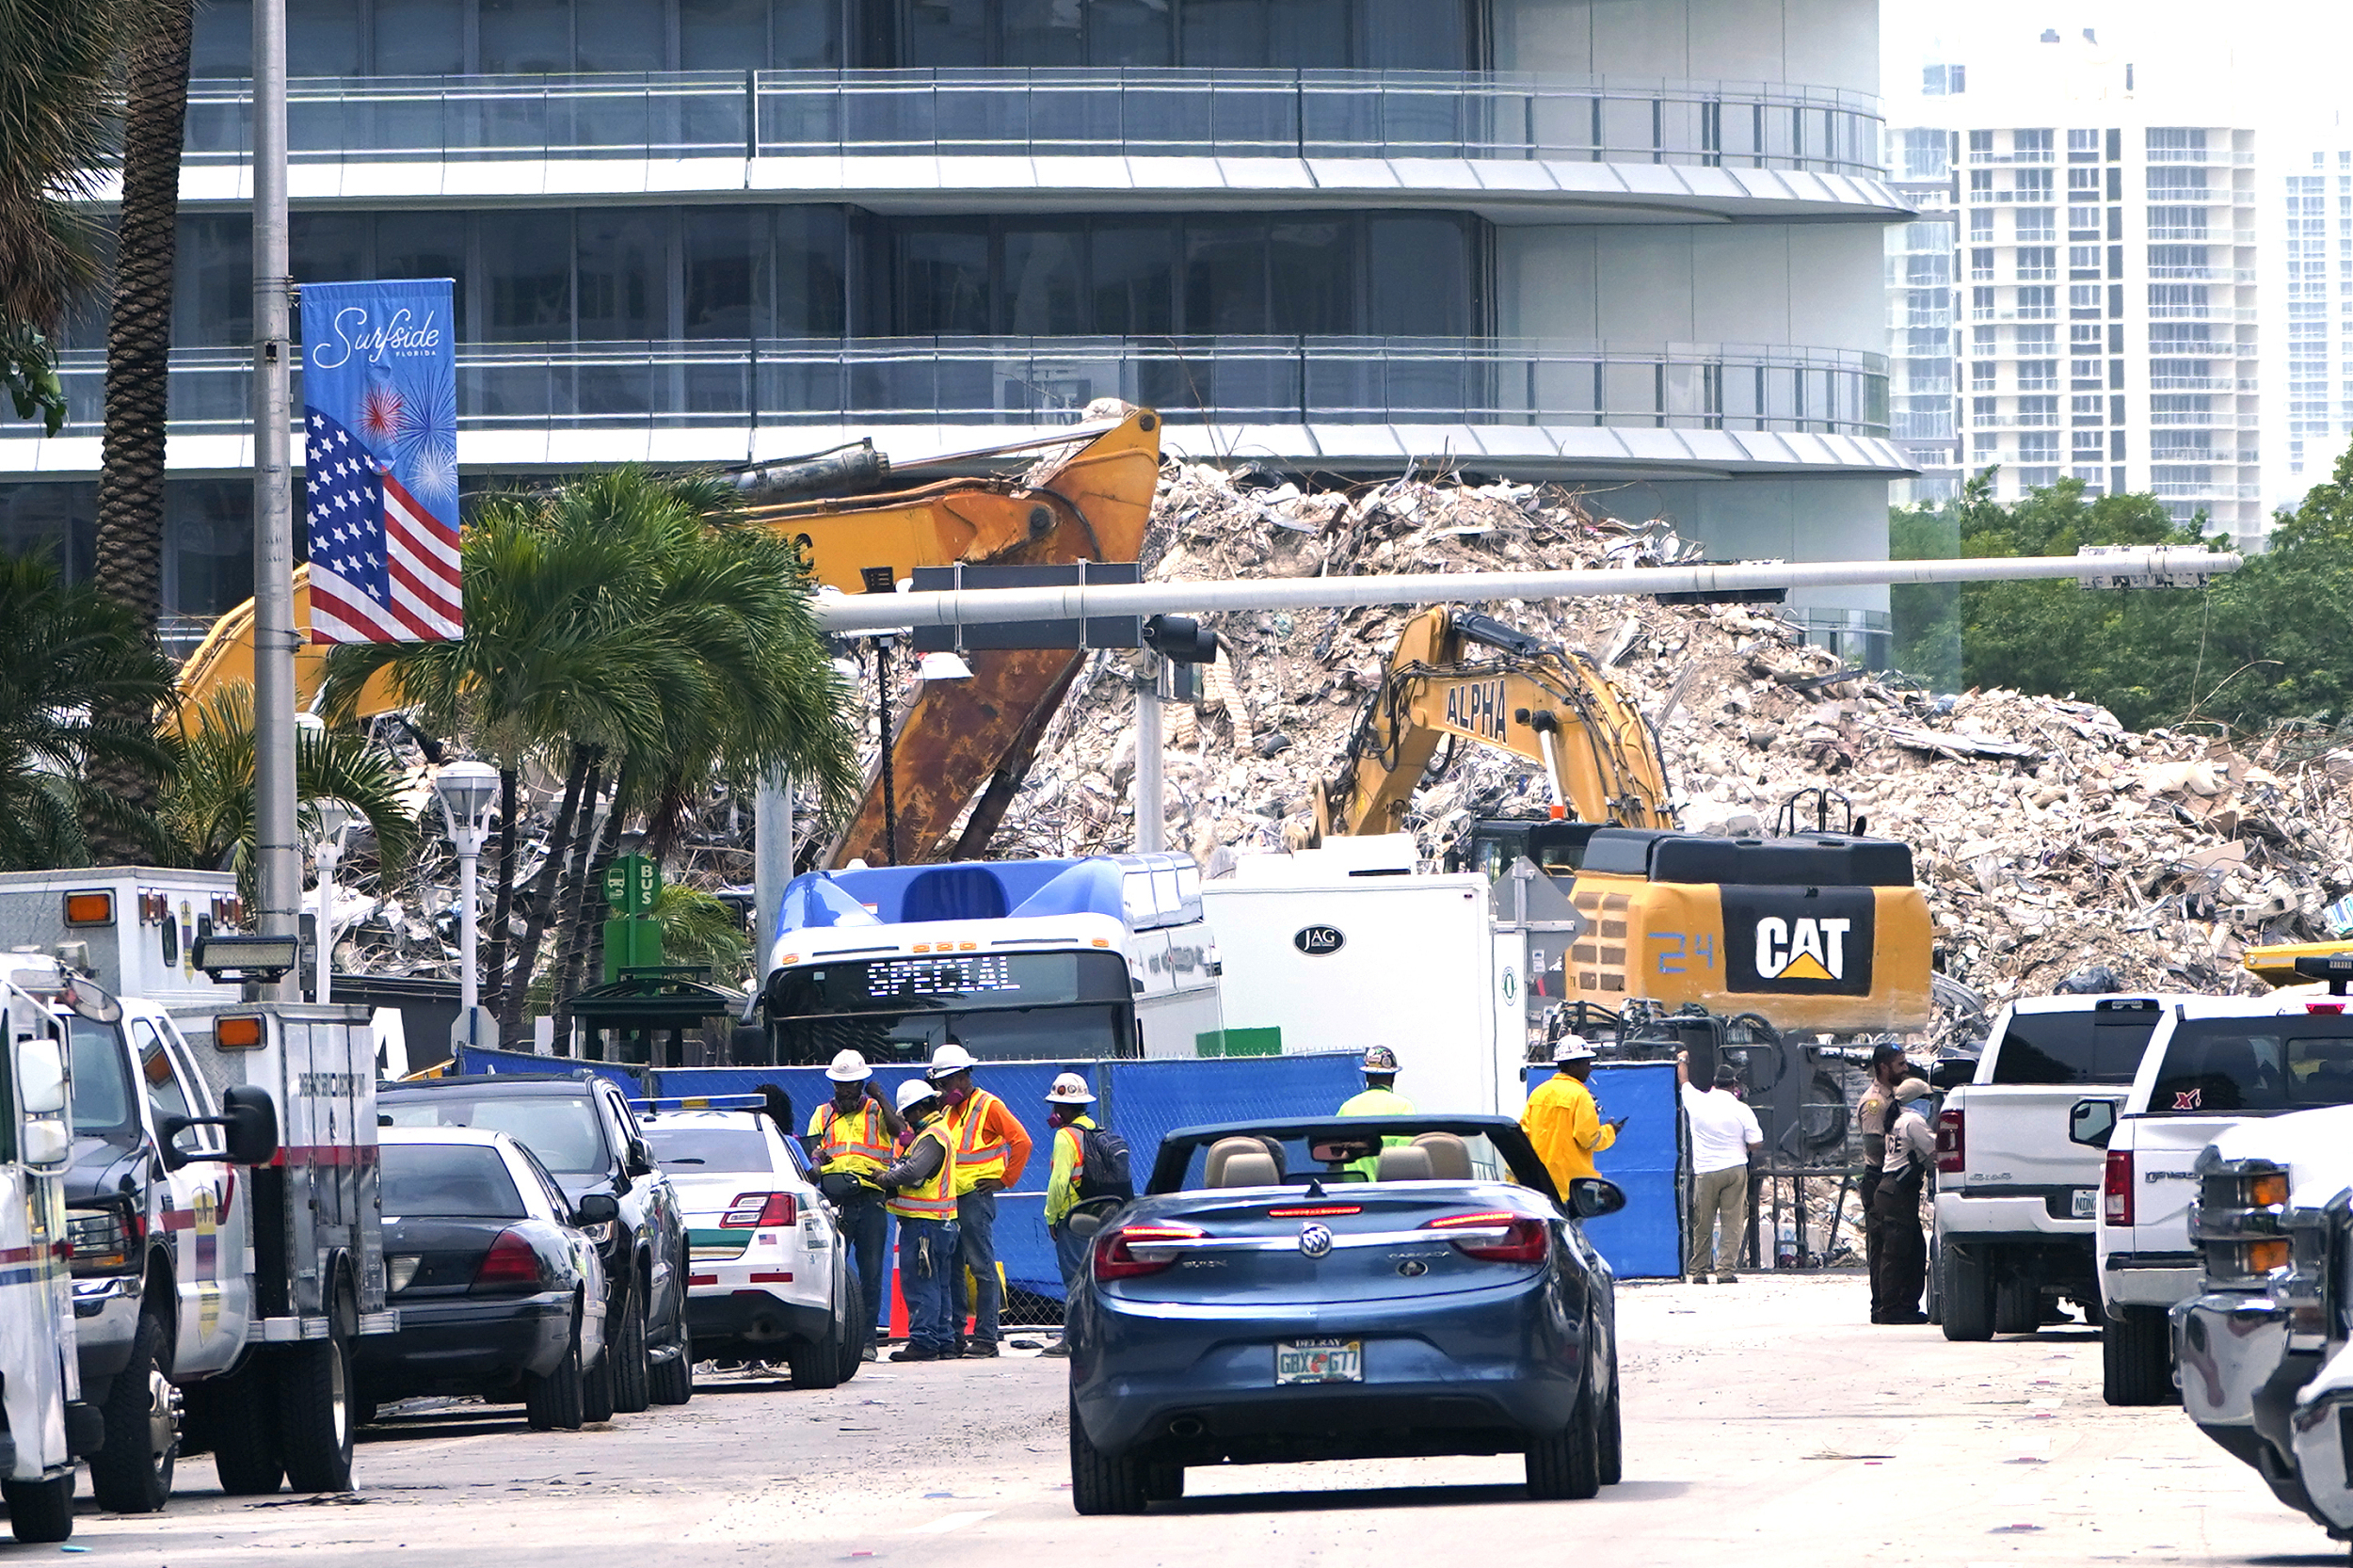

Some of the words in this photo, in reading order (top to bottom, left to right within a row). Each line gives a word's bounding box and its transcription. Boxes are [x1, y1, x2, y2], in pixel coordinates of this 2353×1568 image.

[312, 307, 439, 369] Surfside
[1446, 679, 1508, 745] ALPHA
[641, 865, 653, 904] BUS
[1304, 929, 1336, 951] JAG
[1647, 933, 1713, 973] 24
[1756, 917, 1849, 980] CAT
[868, 955, 1021, 996] SPECIAL
